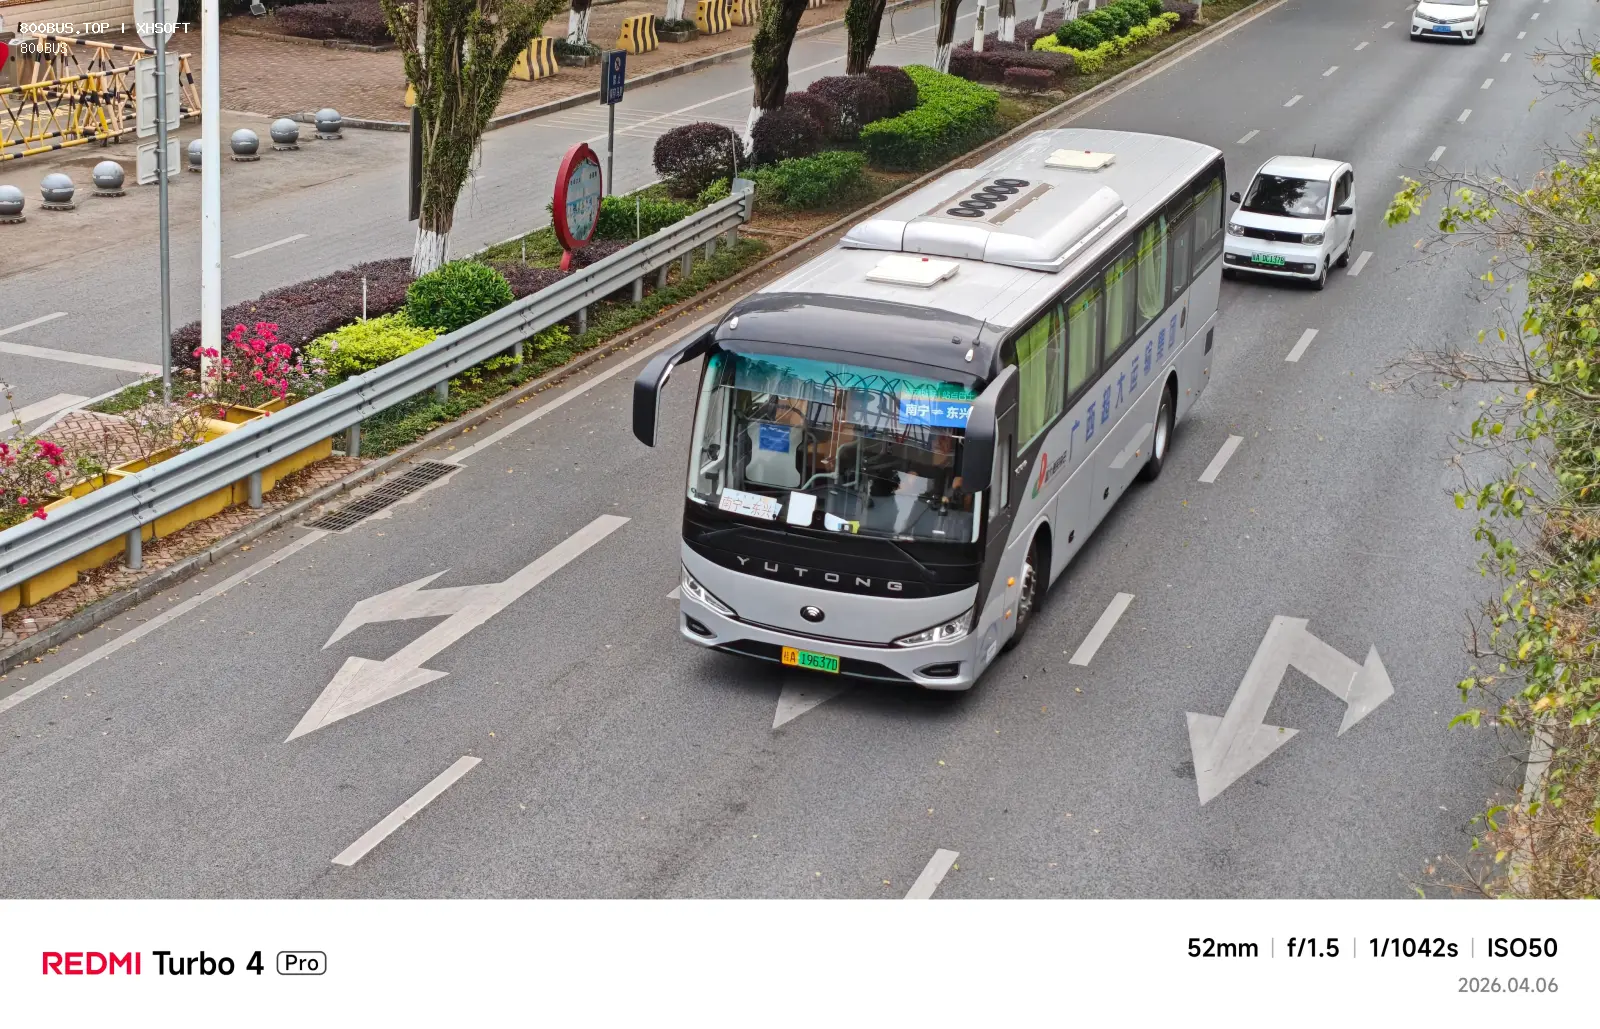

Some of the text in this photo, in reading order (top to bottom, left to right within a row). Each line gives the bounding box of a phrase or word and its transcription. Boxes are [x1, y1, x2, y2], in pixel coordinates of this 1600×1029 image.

[905, 403, 930, 417] 南宁
[737, 555, 903, 591] YUTONG
[801, 653, 838, 671] 19637D
